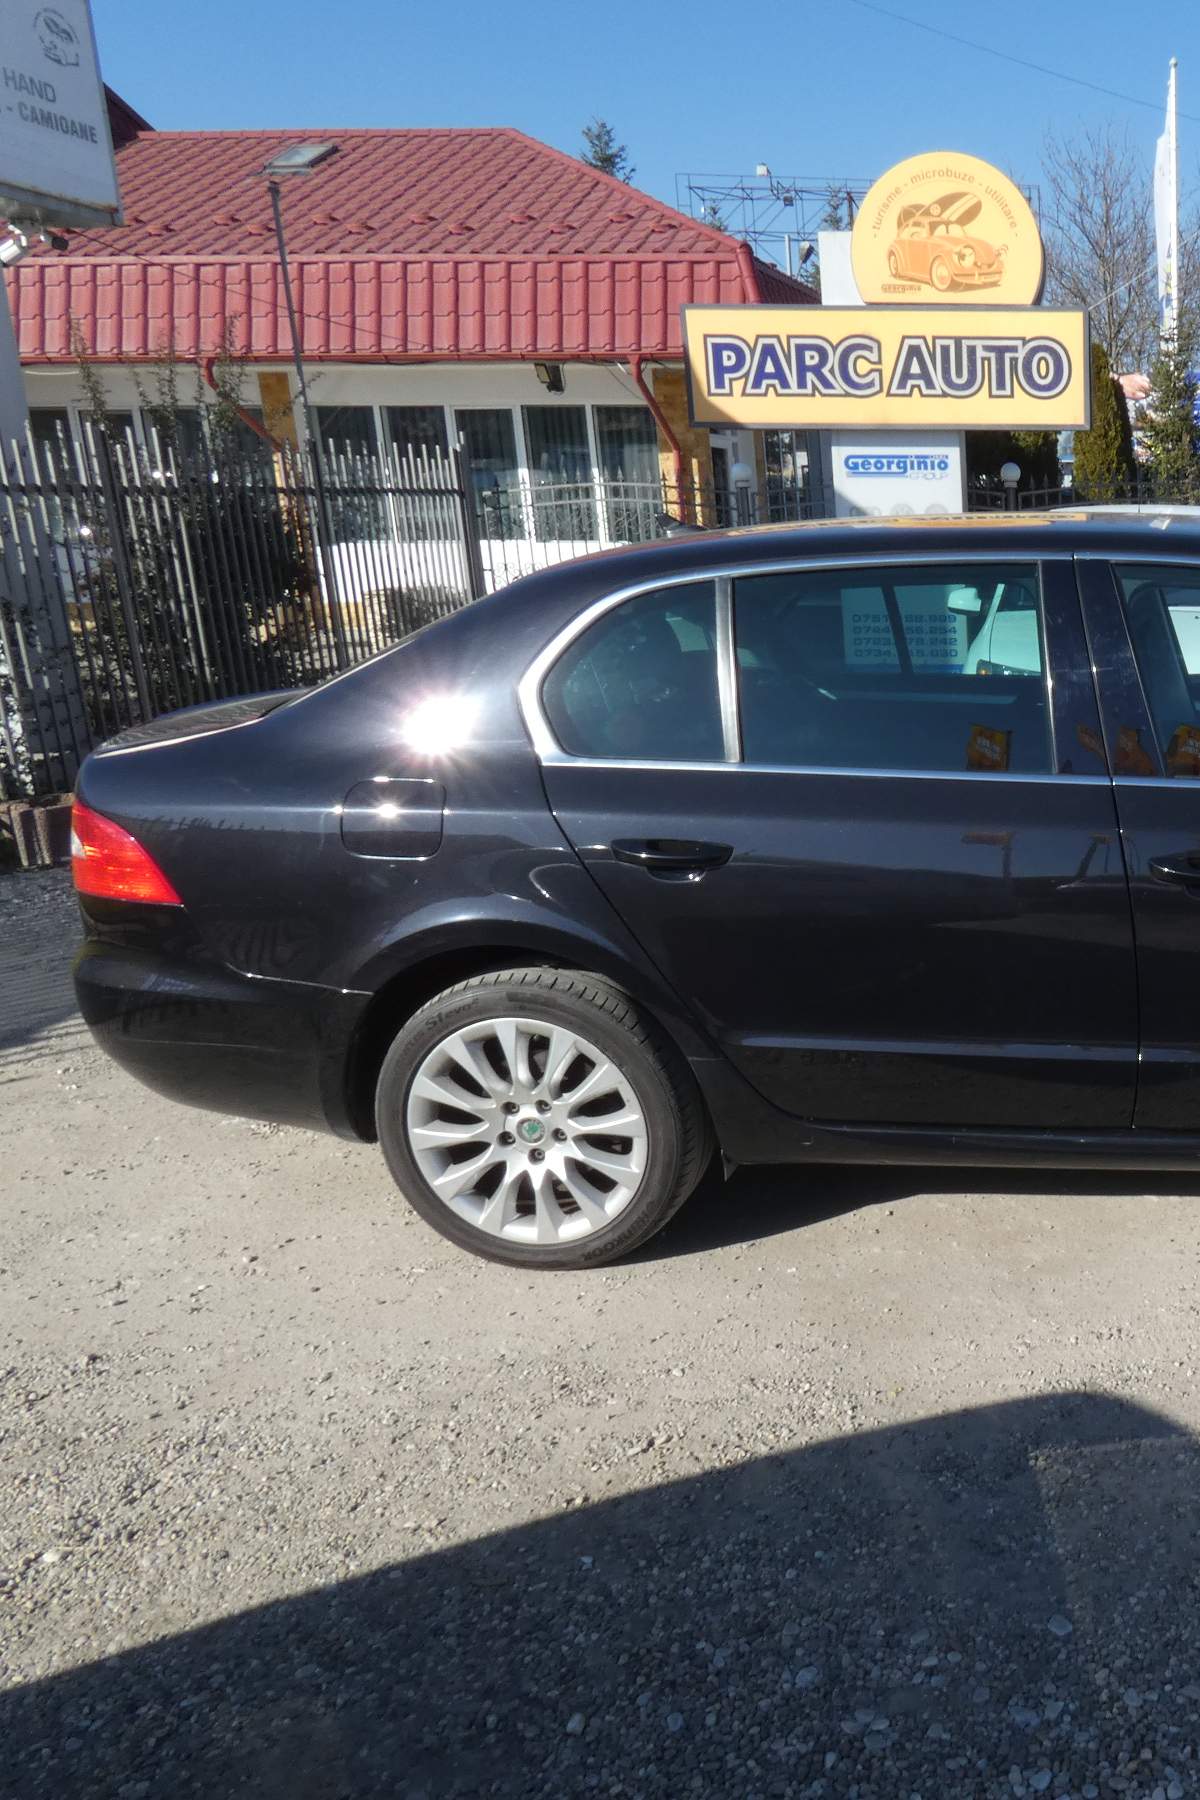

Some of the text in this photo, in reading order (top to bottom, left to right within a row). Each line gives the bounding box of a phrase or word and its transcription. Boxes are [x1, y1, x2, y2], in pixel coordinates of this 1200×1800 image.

[2, 67, 57, 103] HAND
[18, 101, 98, 144] CAMIOANE
[873, 186, 903, 231] turisme
[910, 168, 976, 184] microbuze
[985, 185, 1018, 229] utilitare
[703, 333, 1072, 399] PARC AUTO
[844, 454, 949, 476] Georginio
